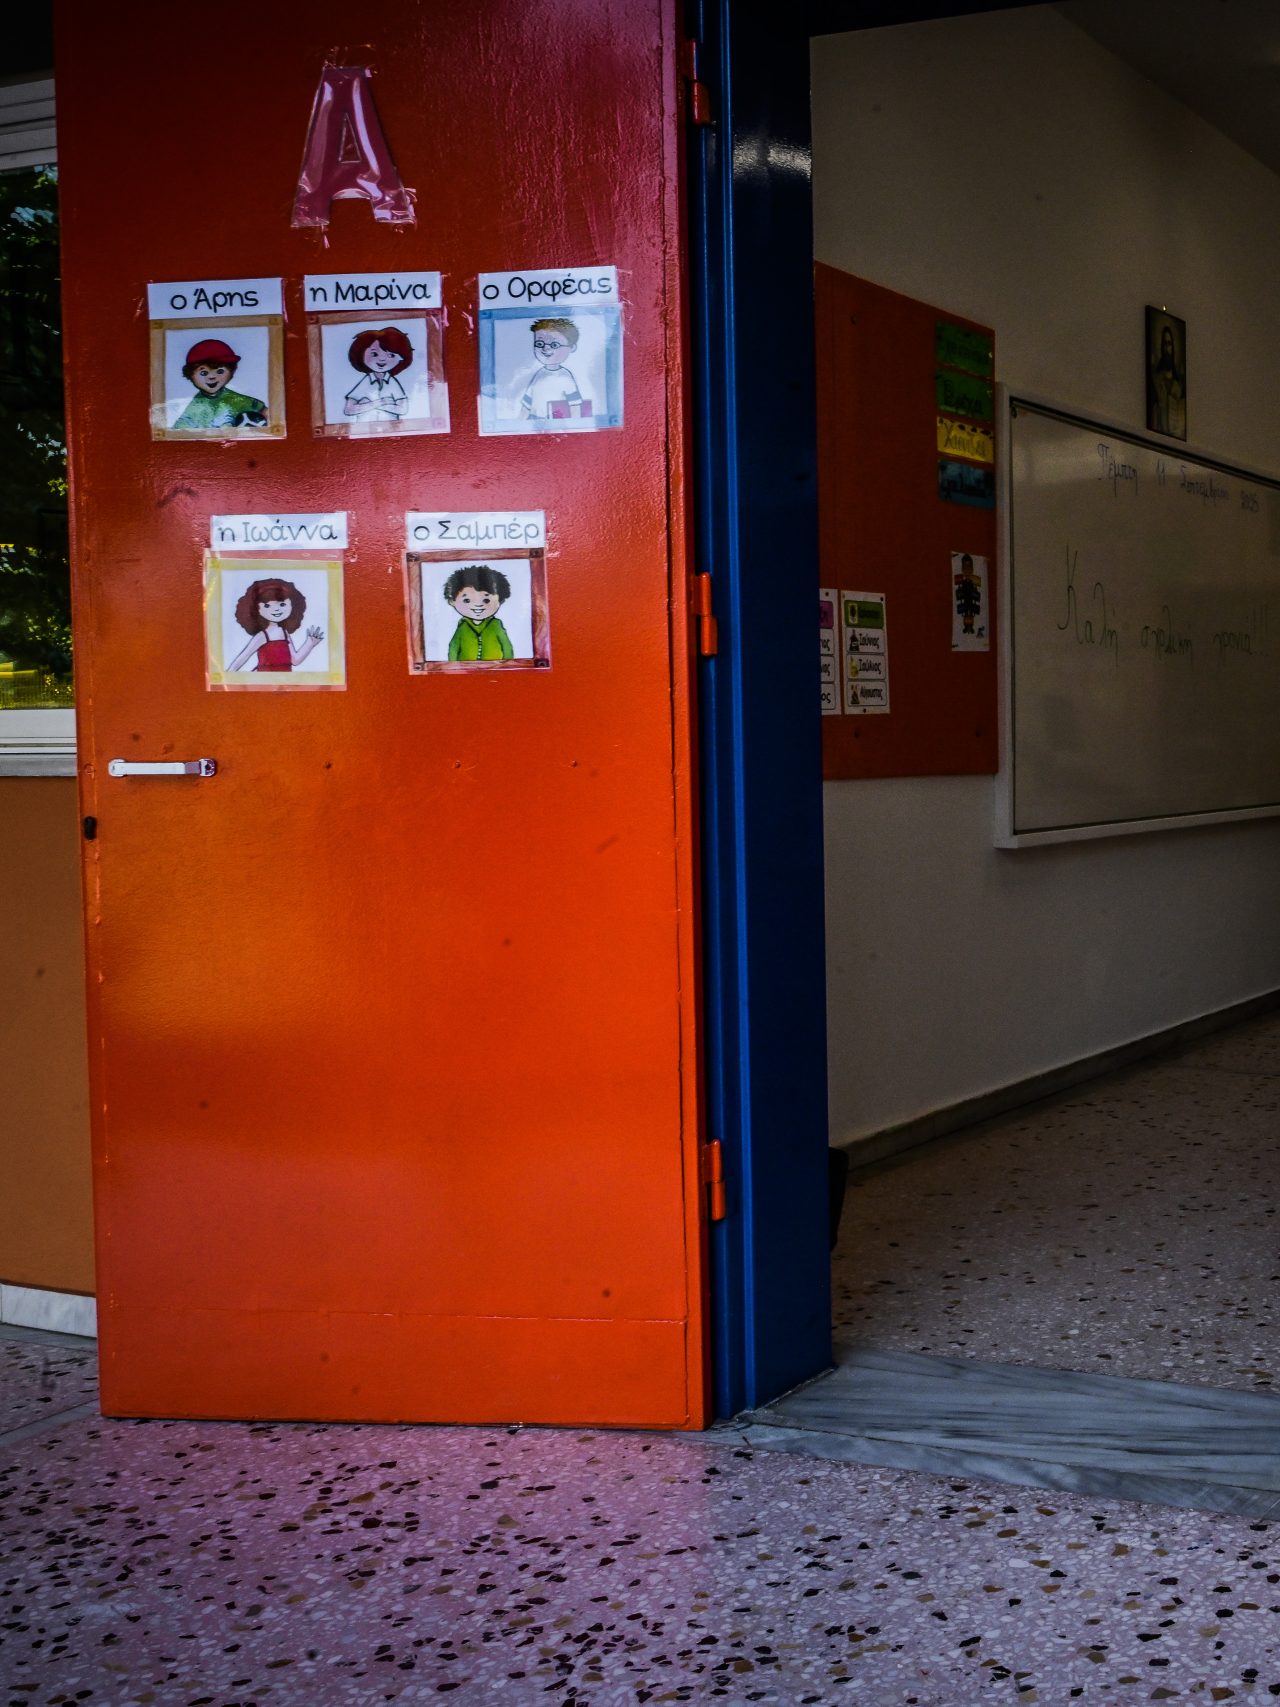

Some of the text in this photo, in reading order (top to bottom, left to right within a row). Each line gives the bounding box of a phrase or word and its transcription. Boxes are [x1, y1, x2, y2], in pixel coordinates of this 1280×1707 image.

[291, 66, 416, 228] Α
[170, 287, 259, 313] ο Άρης
[310, 279, 431, 305] η Μαρίνα
[482, 273, 612, 302] ο Ορφέας
[218, 518, 338, 543] η Ιωάννα
[414, 518, 539, 547] ο Σαμπέρ
[1057, 543, 1119, 668] Καλή
